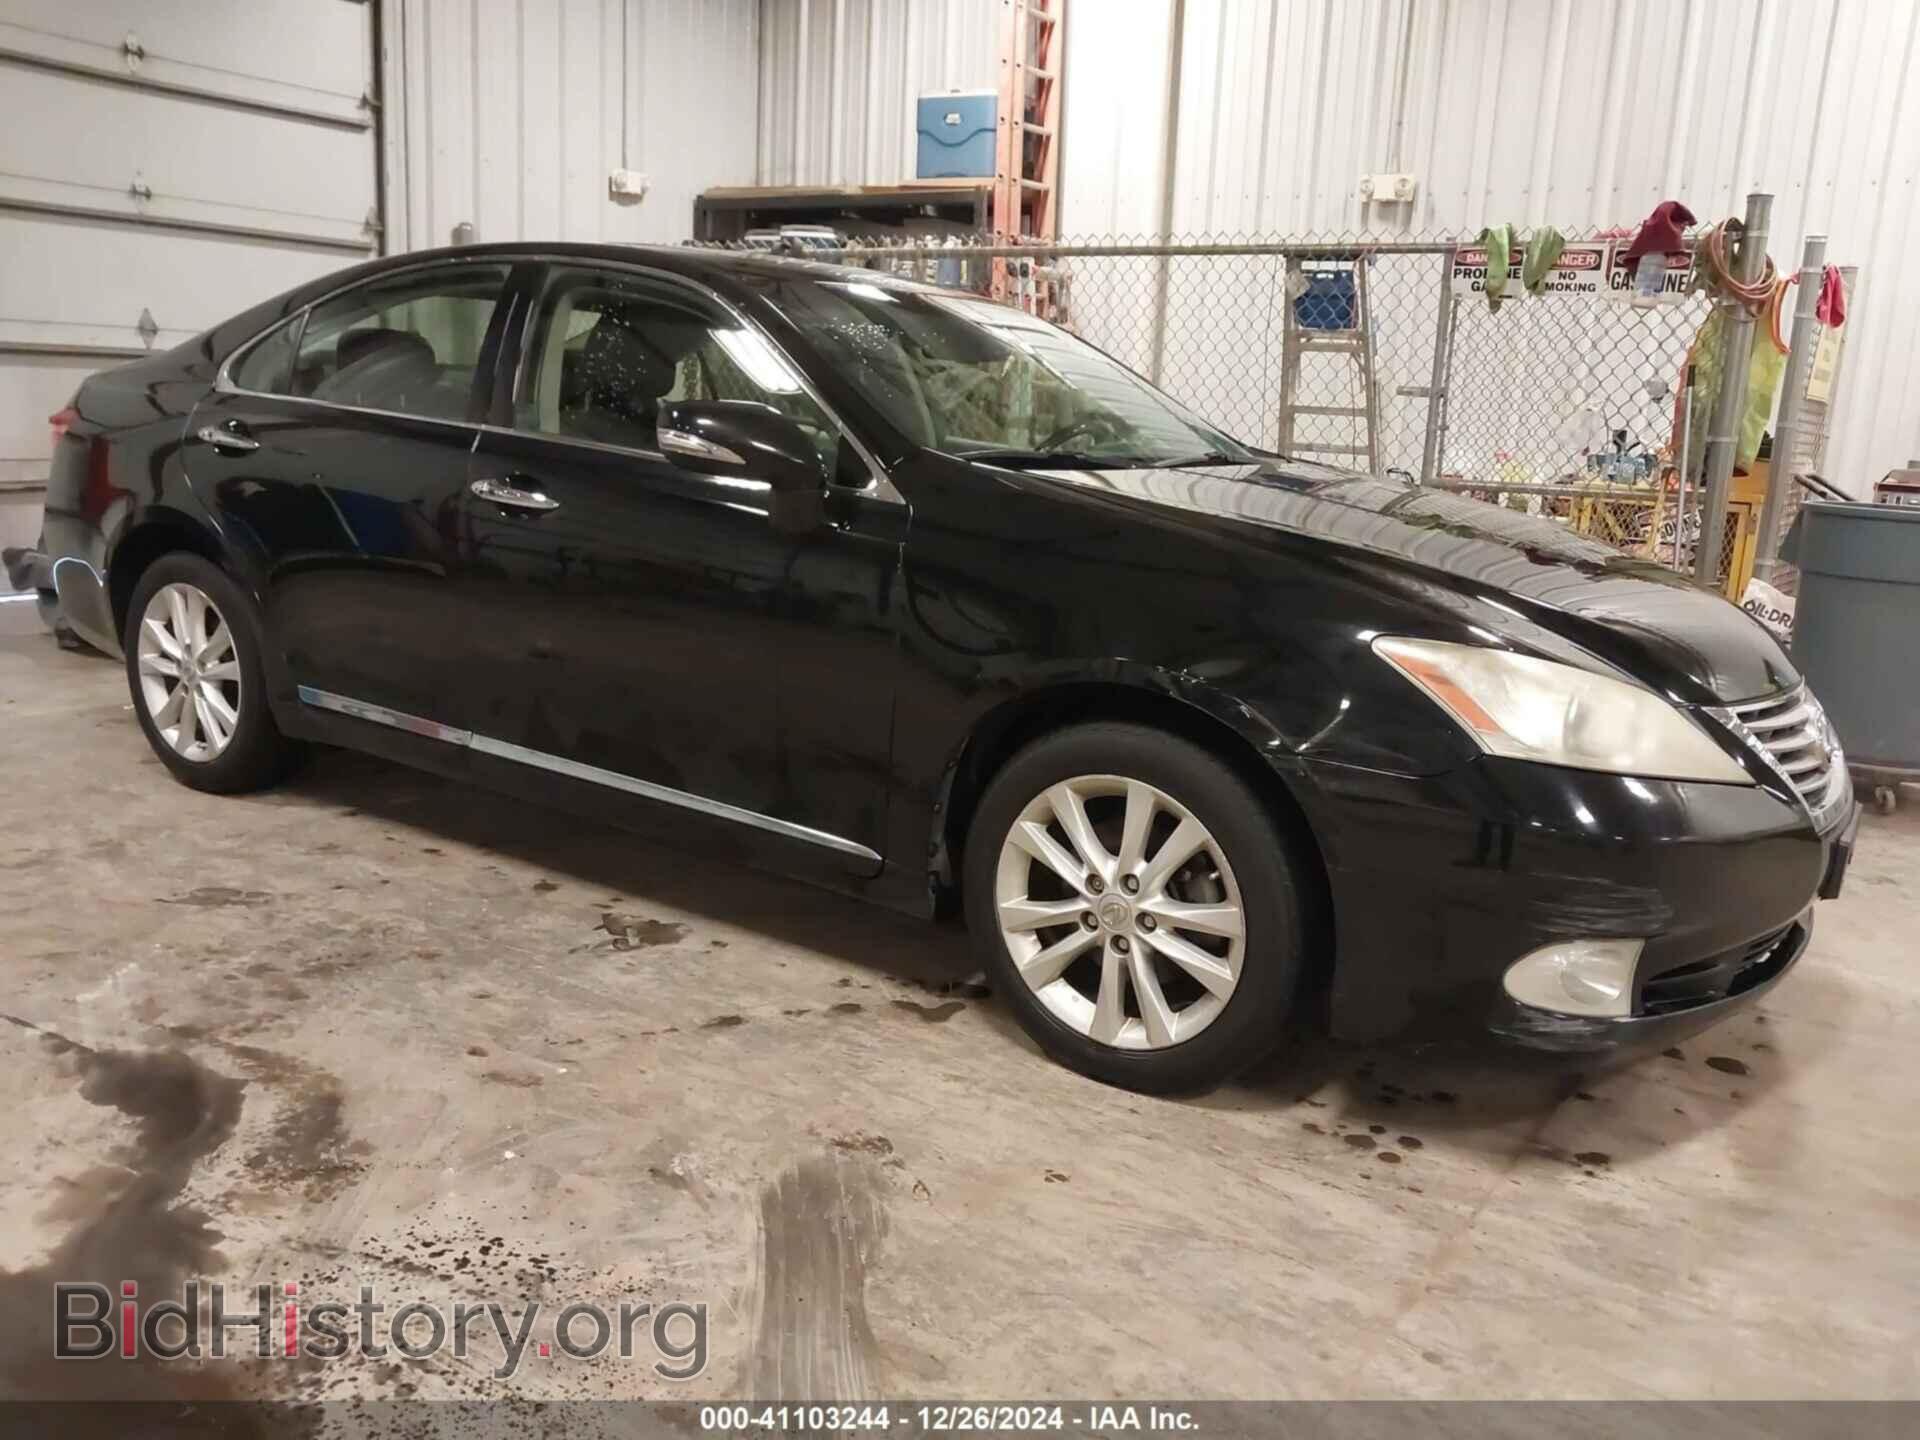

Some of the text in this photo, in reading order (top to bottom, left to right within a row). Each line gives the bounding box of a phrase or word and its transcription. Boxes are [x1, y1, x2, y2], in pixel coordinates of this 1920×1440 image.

[1556, 252, 1596, 266] NGER
[1453, 268, 1521, 280] PRONE
[1558, 271, 1577, 281] NO
[1544, 282, 1597, 293] MOKING
[1610, 271, 1688, 293] GAINE
